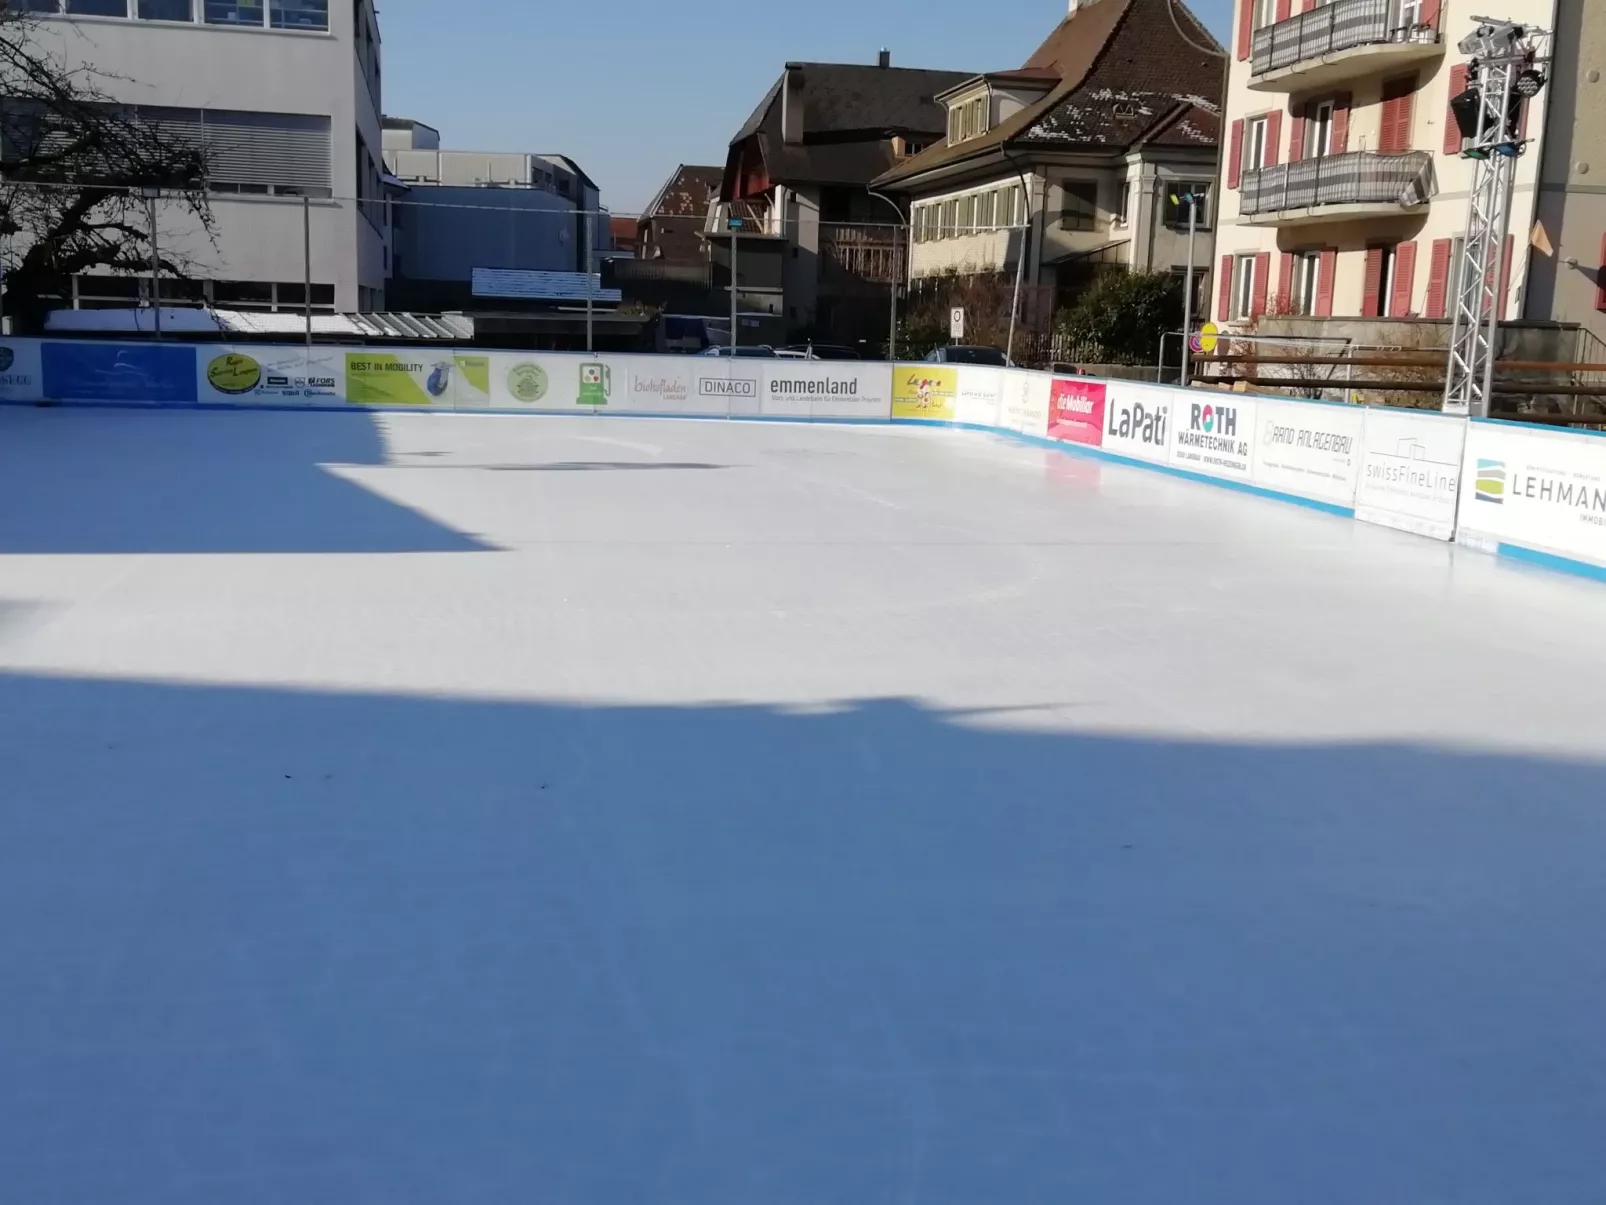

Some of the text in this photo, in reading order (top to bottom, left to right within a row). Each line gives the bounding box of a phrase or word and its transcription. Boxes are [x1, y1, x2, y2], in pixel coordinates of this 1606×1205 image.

[350, 361, 423, 372] BEST IN MOBILITY
[704, 381, 751, 394] DINACO
[770, 377, 857, 394] emmenland
[1066, 394, 1095, 414] Mobiliar
[1108, 398, 1168, 446] LaPati
[1190, 403, 1237, 437] ROTH
[1178, 429, 1248, 456] WÄRMETECHNIK AG
[1367, 462, 1456, 492] swissFineLine
